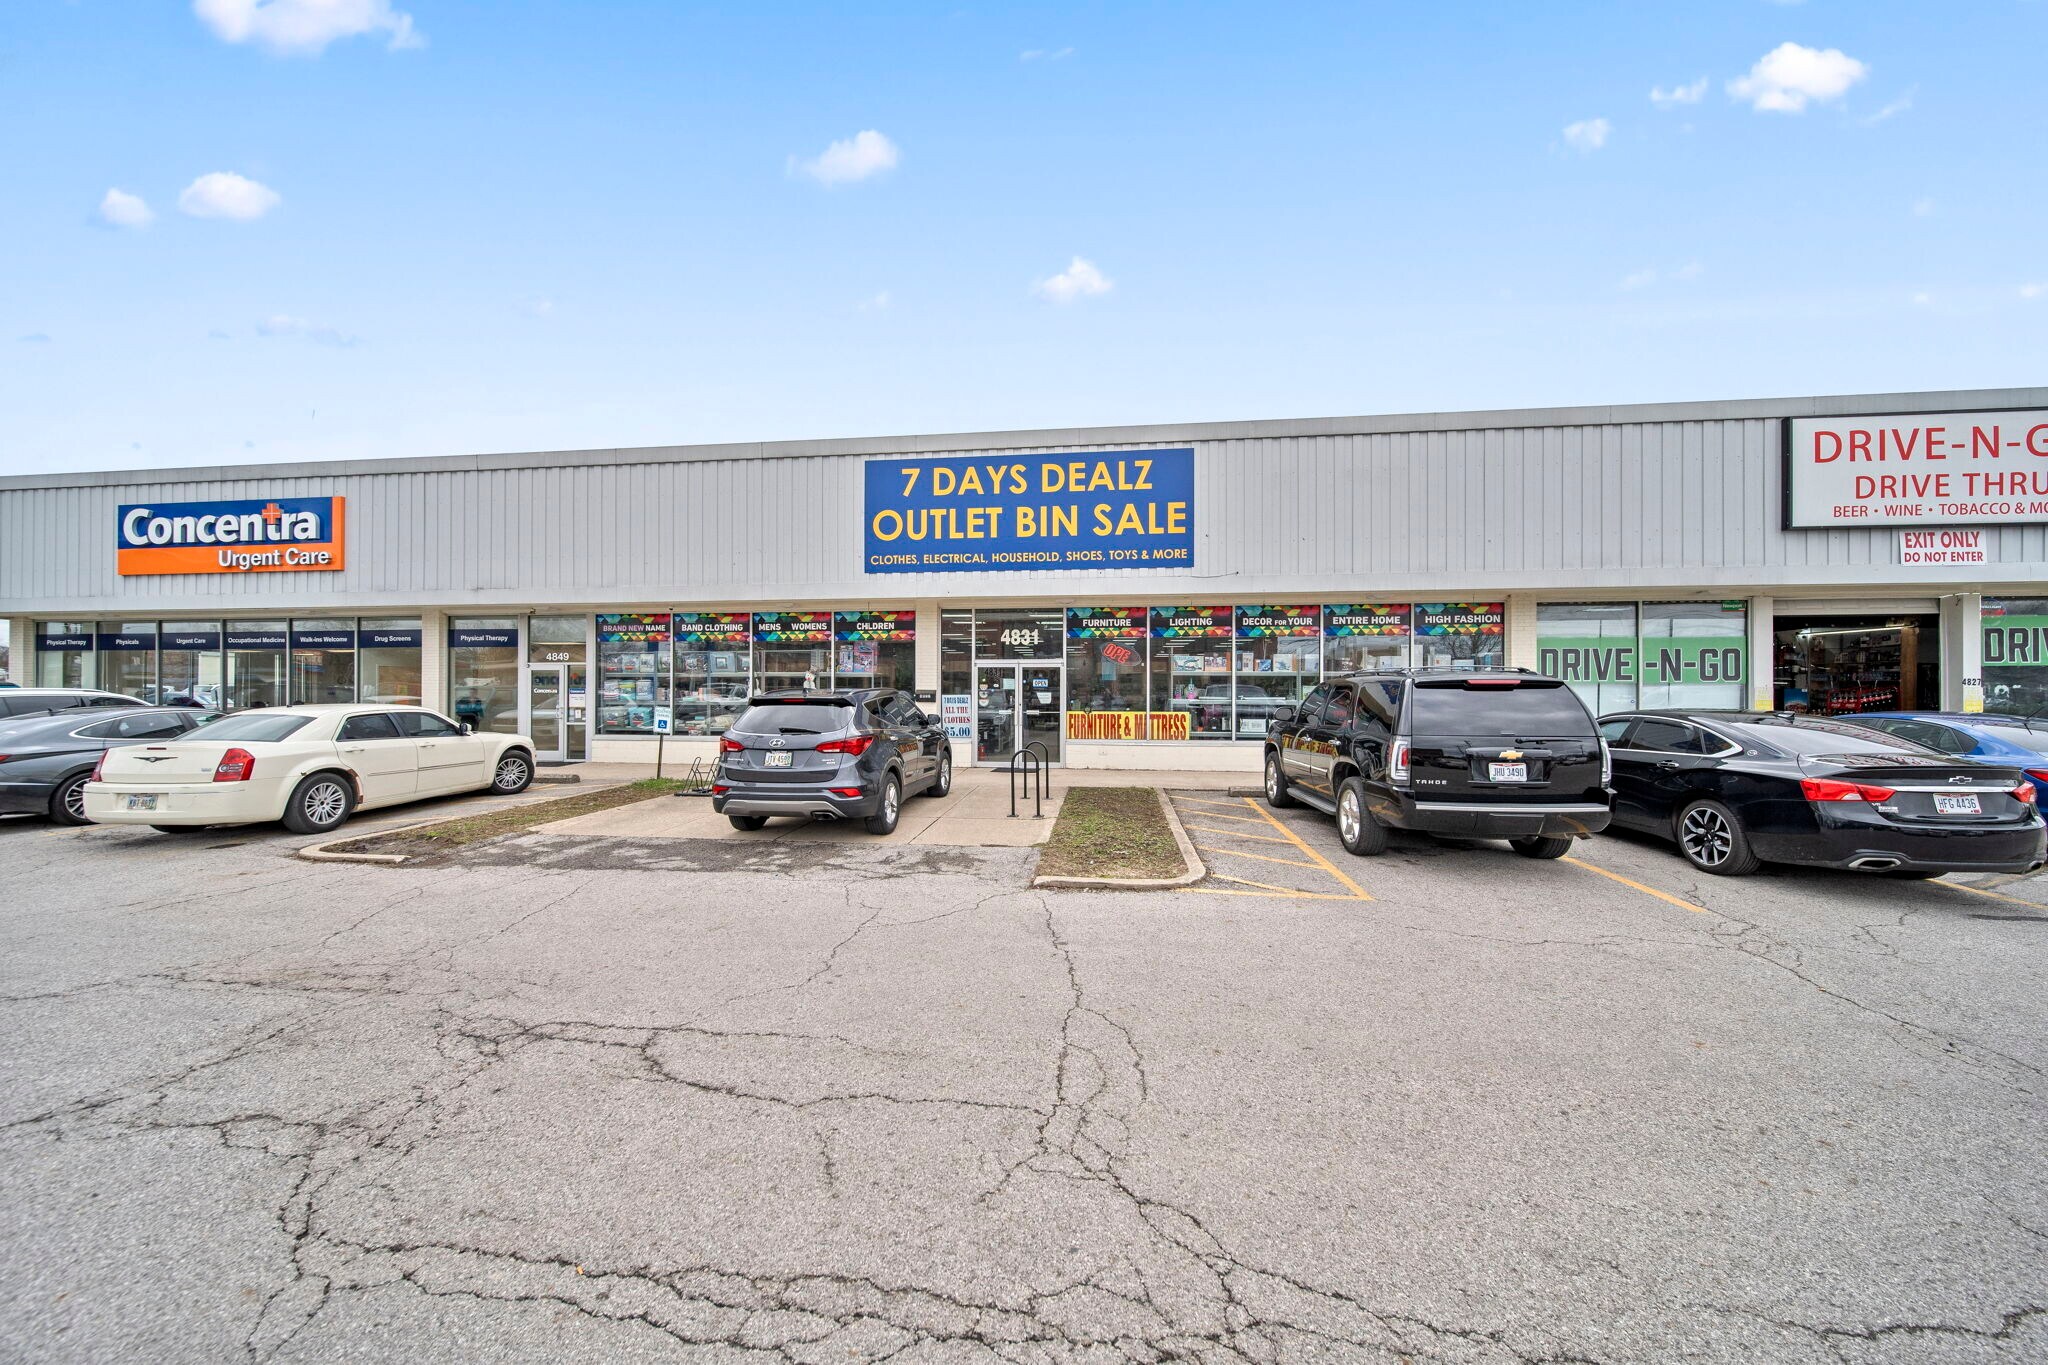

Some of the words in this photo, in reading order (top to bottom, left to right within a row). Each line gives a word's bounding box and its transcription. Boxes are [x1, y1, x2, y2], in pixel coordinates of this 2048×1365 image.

[1813, 423, 2048, 464] DRIVE-N-G
[901, 467, 921, 497] 7
[932, 464, 1028, 497] DAYS
[1041, 459, 1153, 493] DEALZ
[1855, 473, 1950, 500] DRIVE
[1962, 470, 2048, 497] THRU
[1833, 505, 1868, 518] BEER
[1884, 503, 1923, 517] WINE
[1938, 502, 2011, 516] TOBACCO
[2014, 501, 2026, 515] &
[123, 503, 320, 547] Concentra
[872, 506, 1003, 542] OUTLET
[1016, 504, 1078, 538] BIN
[1092, 501, 1187, 536] SALE
[1904, 532, 1935, 549] EXIT
[1940, 530, 1980, 548] ONLY
[218, 549, 281, 569] Urgent
[285, 547, 329, 565] Care
[870, 554, 920, 567] CLOTHES,
[922, 552, 989, 565] ELECTRICAL,
[991, 551, 1063, 563] HOUSEHOLD,
[1066, 549, 1106, 562] SHOES,
[1109, 549, 1139, 560] TOYS
[1141, 548, 1150, 560] &
[1153, 548, 1188, 559] MORE
[1904, 552, 1921, 563] DO
[1924, 551, 1947, 563] NOT
[1950, 551, 1983, 562] ENTER
[1082, 618, 1132, 628] FURNITURE
[1169, 617, 1213, 627] LIGHTING
[1242, 617, 1273, 627] DECOR
[1287, 616, 1313, 626] YOUR
[1332, 616, 1368, 625] ENTIRE
[1371, 615, 1401, 625] HOME
[1424, 614, 1452, 624] HIGH
[1453, 613, 1501, 624] FASHION
[603, 624, 627, 632] BRAND
[628, 624, 645, 632] NEW
[645, 624, 666, 632] NAME
[681, 624, 703, 632] BAND
[704, 623, 744, 632] CLOTHING
[758, 623, 782, 631] MENS
[791, 622, 828, 630] WOMENS
[176, 637, 193, 646] Urgent
[193, 637, 206, 645] Care
[227, 636, 262, 645] Occupational
[262, 636, 286, 644] Medicine
[374, 635, 388, 643] Drug
[389, 635, 412, 643] Screens
[460, 634, 484, 643] Physical
[485, 634, 508, 643] Therapy
[1000, 627, 1040, 646] 4831
[46, 638, 67, 647] Physical
[67, 638, 86, 647] Therapy
[115, 638, 140, 647] Physicals
[545, 652, 570, 661] 4849
[1539, 647, 1634, 682] DRIVE
[1643, 647, 1742, 683] -N-GO
[1962, 677, 1982, 687] 4827
[945, 706, 956, 714] ALL
[956, 706, 969, 714] THE
[944, 716, 971, 724] CLOTHES
[945, 726, 970, 737] $5.00
[1068, 713, 1122, 740] FURNITURE
[1123, 715, 1132, 737] &
[1492, 767, 1505, 777] JHU
[1506, 767, 1524, 777] 3490
[1937, 798, 1955, 809] HFG
[1956, 798, 1977, 809] 4436
